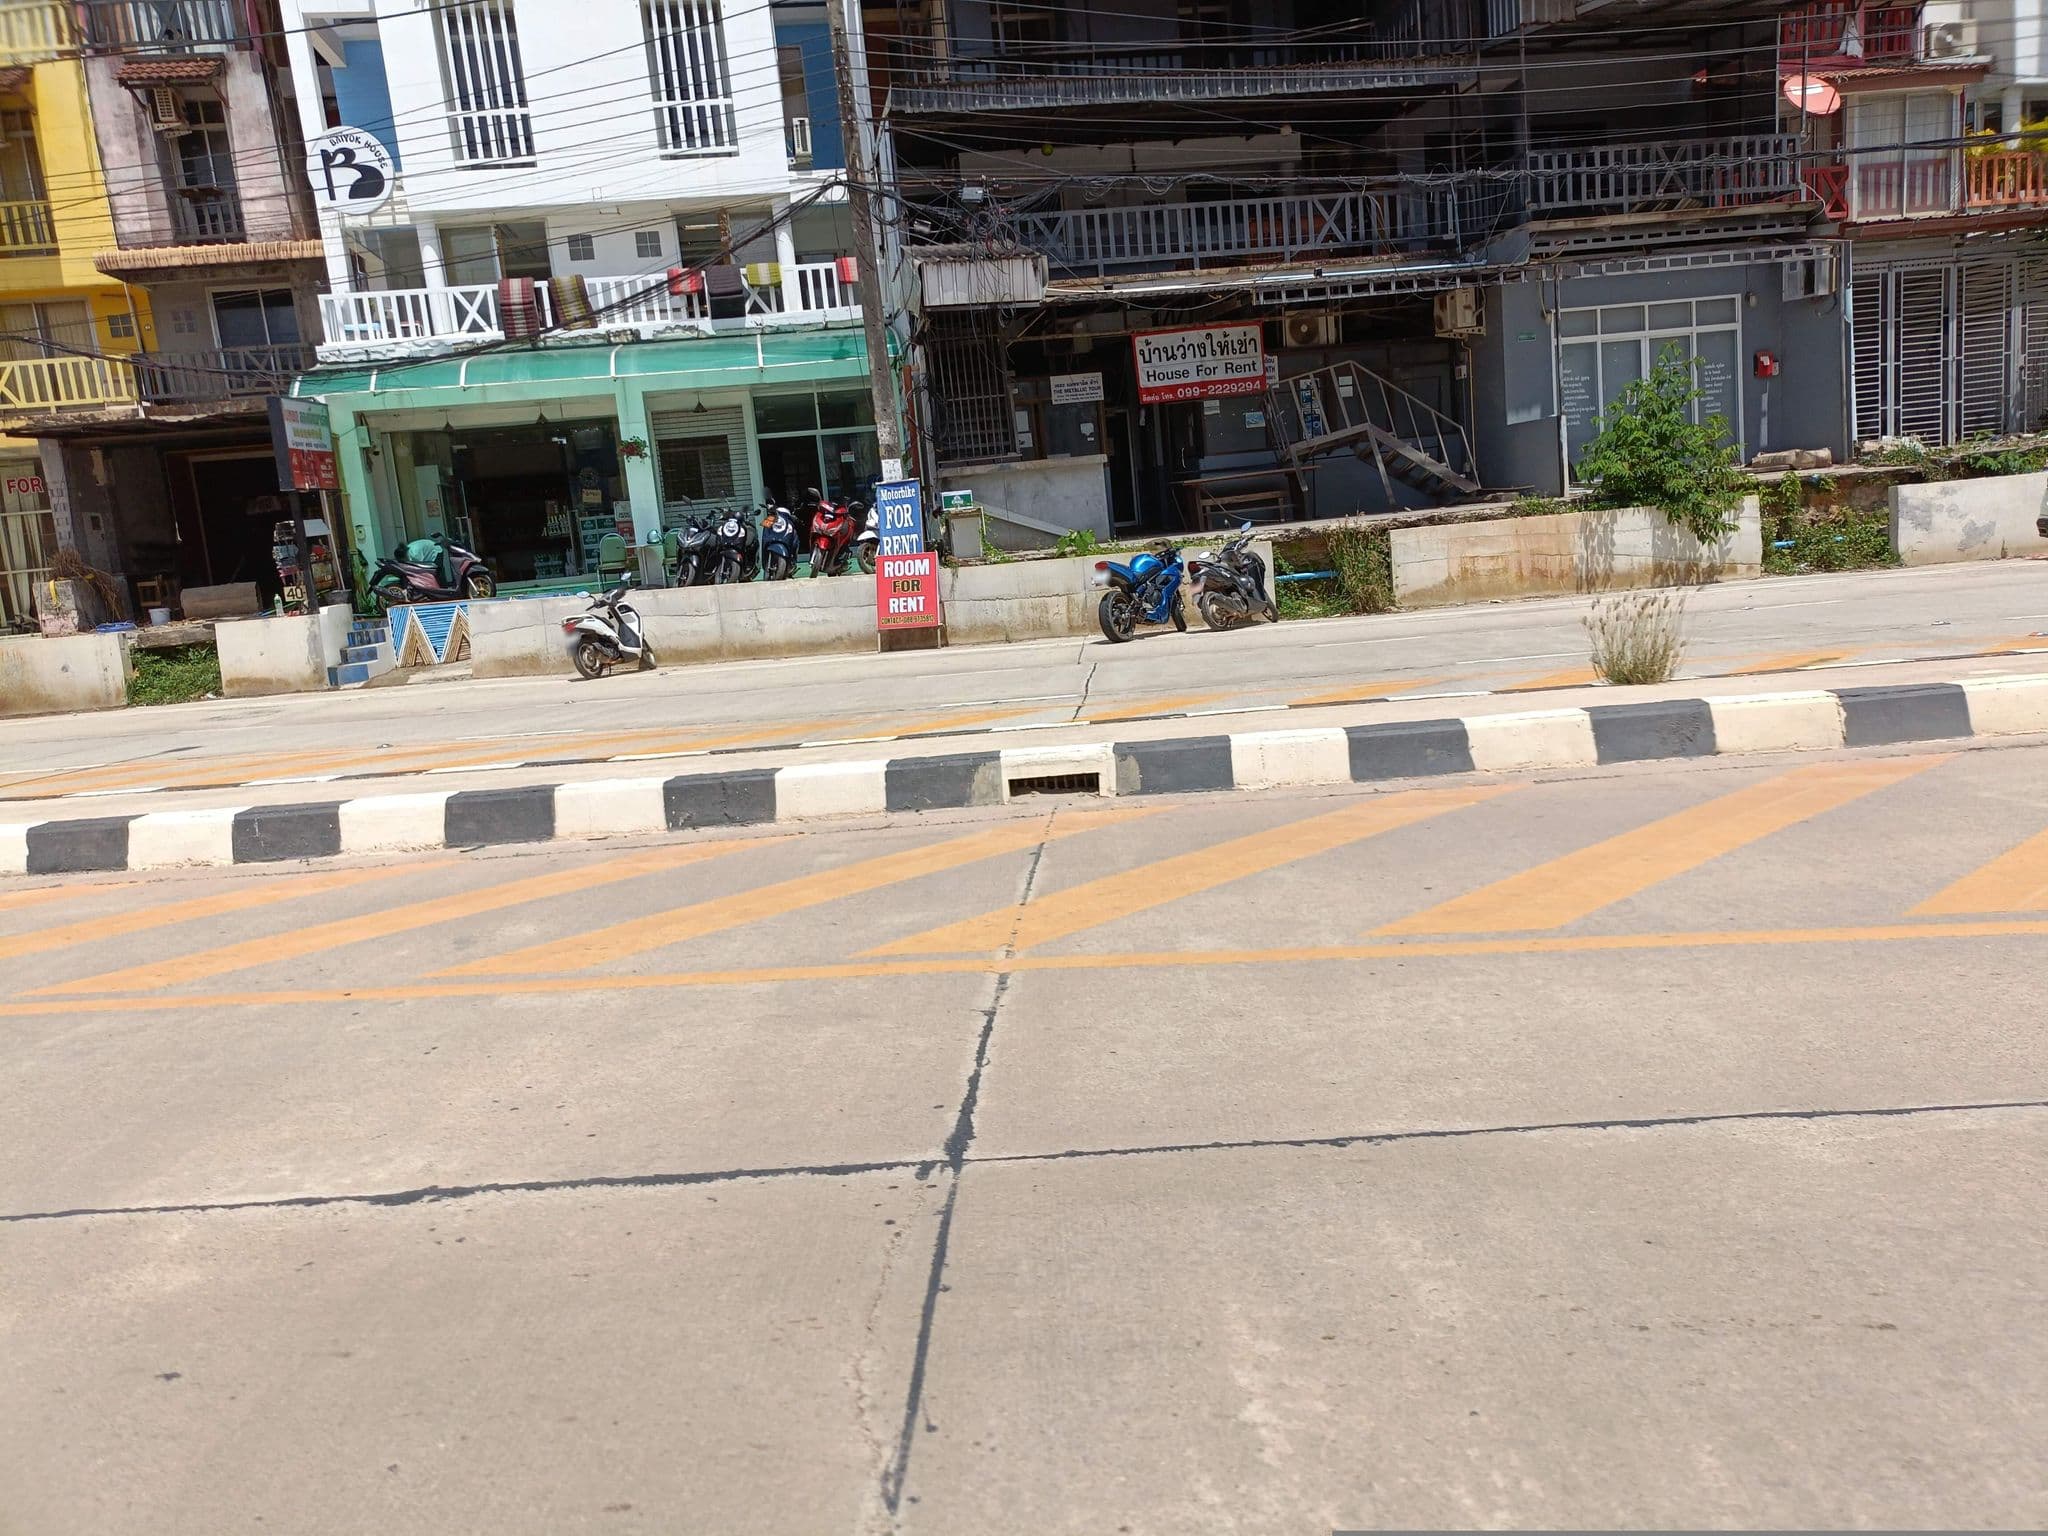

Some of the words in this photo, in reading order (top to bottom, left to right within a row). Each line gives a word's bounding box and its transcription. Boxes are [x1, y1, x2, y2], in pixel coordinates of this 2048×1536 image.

[364, 140, 388, 169] HOUSE
[1139, 330, 1258, 364] บ้านว่างให้เช่า
[1146, 368, 1190, 382] House
[1196, 364, 1219, 377] For
[1225, 360, 1257, 374] Rent
[1177, 380, 1261, 398] 099-2229294
[6, 476, 44, 495] FOR
[880, 485, 916, 501] Motorbike
[885, 504, 914, 529] FOR
[882, 533, 920, 556] RENT
[884, 558, 930, 578] ROOM
[891, 578, 921, 594] FOR
[888, 596, 925, 614] RENT
